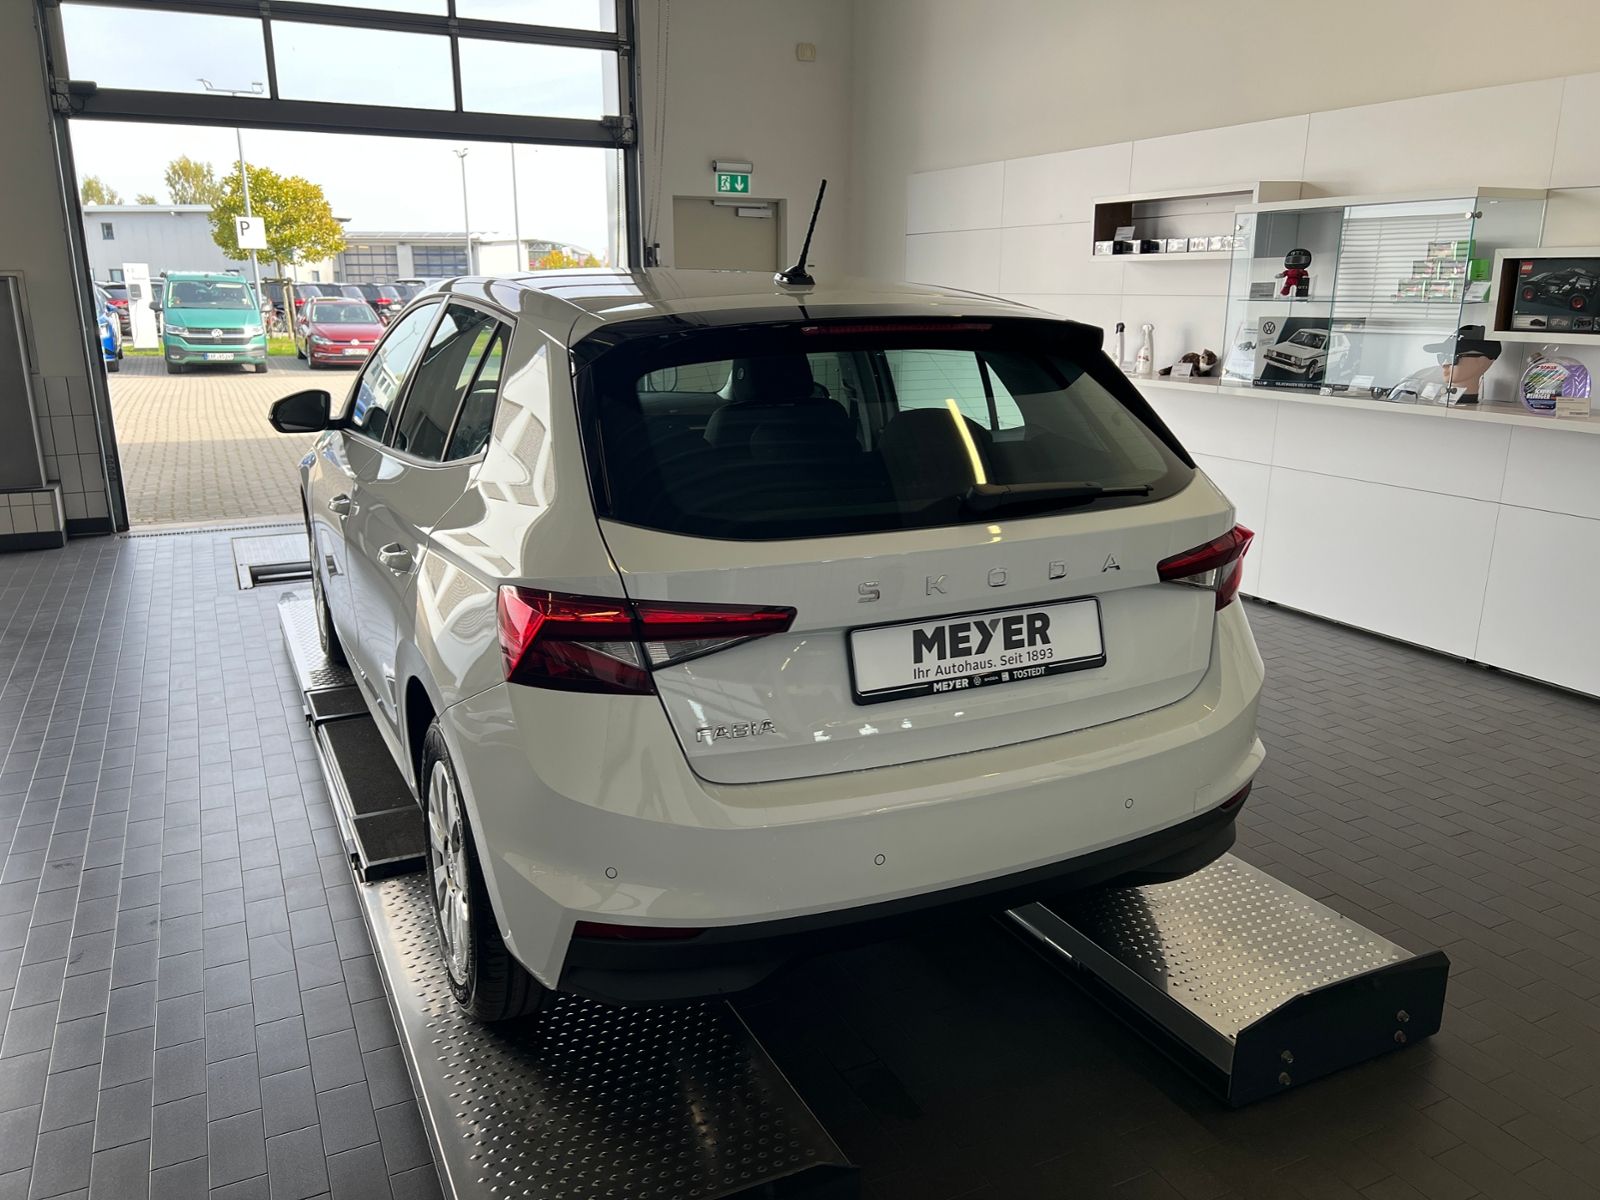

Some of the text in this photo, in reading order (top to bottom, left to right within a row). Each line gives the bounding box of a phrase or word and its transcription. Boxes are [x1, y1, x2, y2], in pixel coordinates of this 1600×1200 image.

[240, 220, 250, 236] P
[912, 612, 1051, 664] MEYER
[913, 648, 1054, 680] Ihr Autohaus. Seit 1893
[933, 678, 969, 693] MEYER
[1012, 666, 1046, 679] TOSTEDT
[695, 718, 777, 743] FABIA
